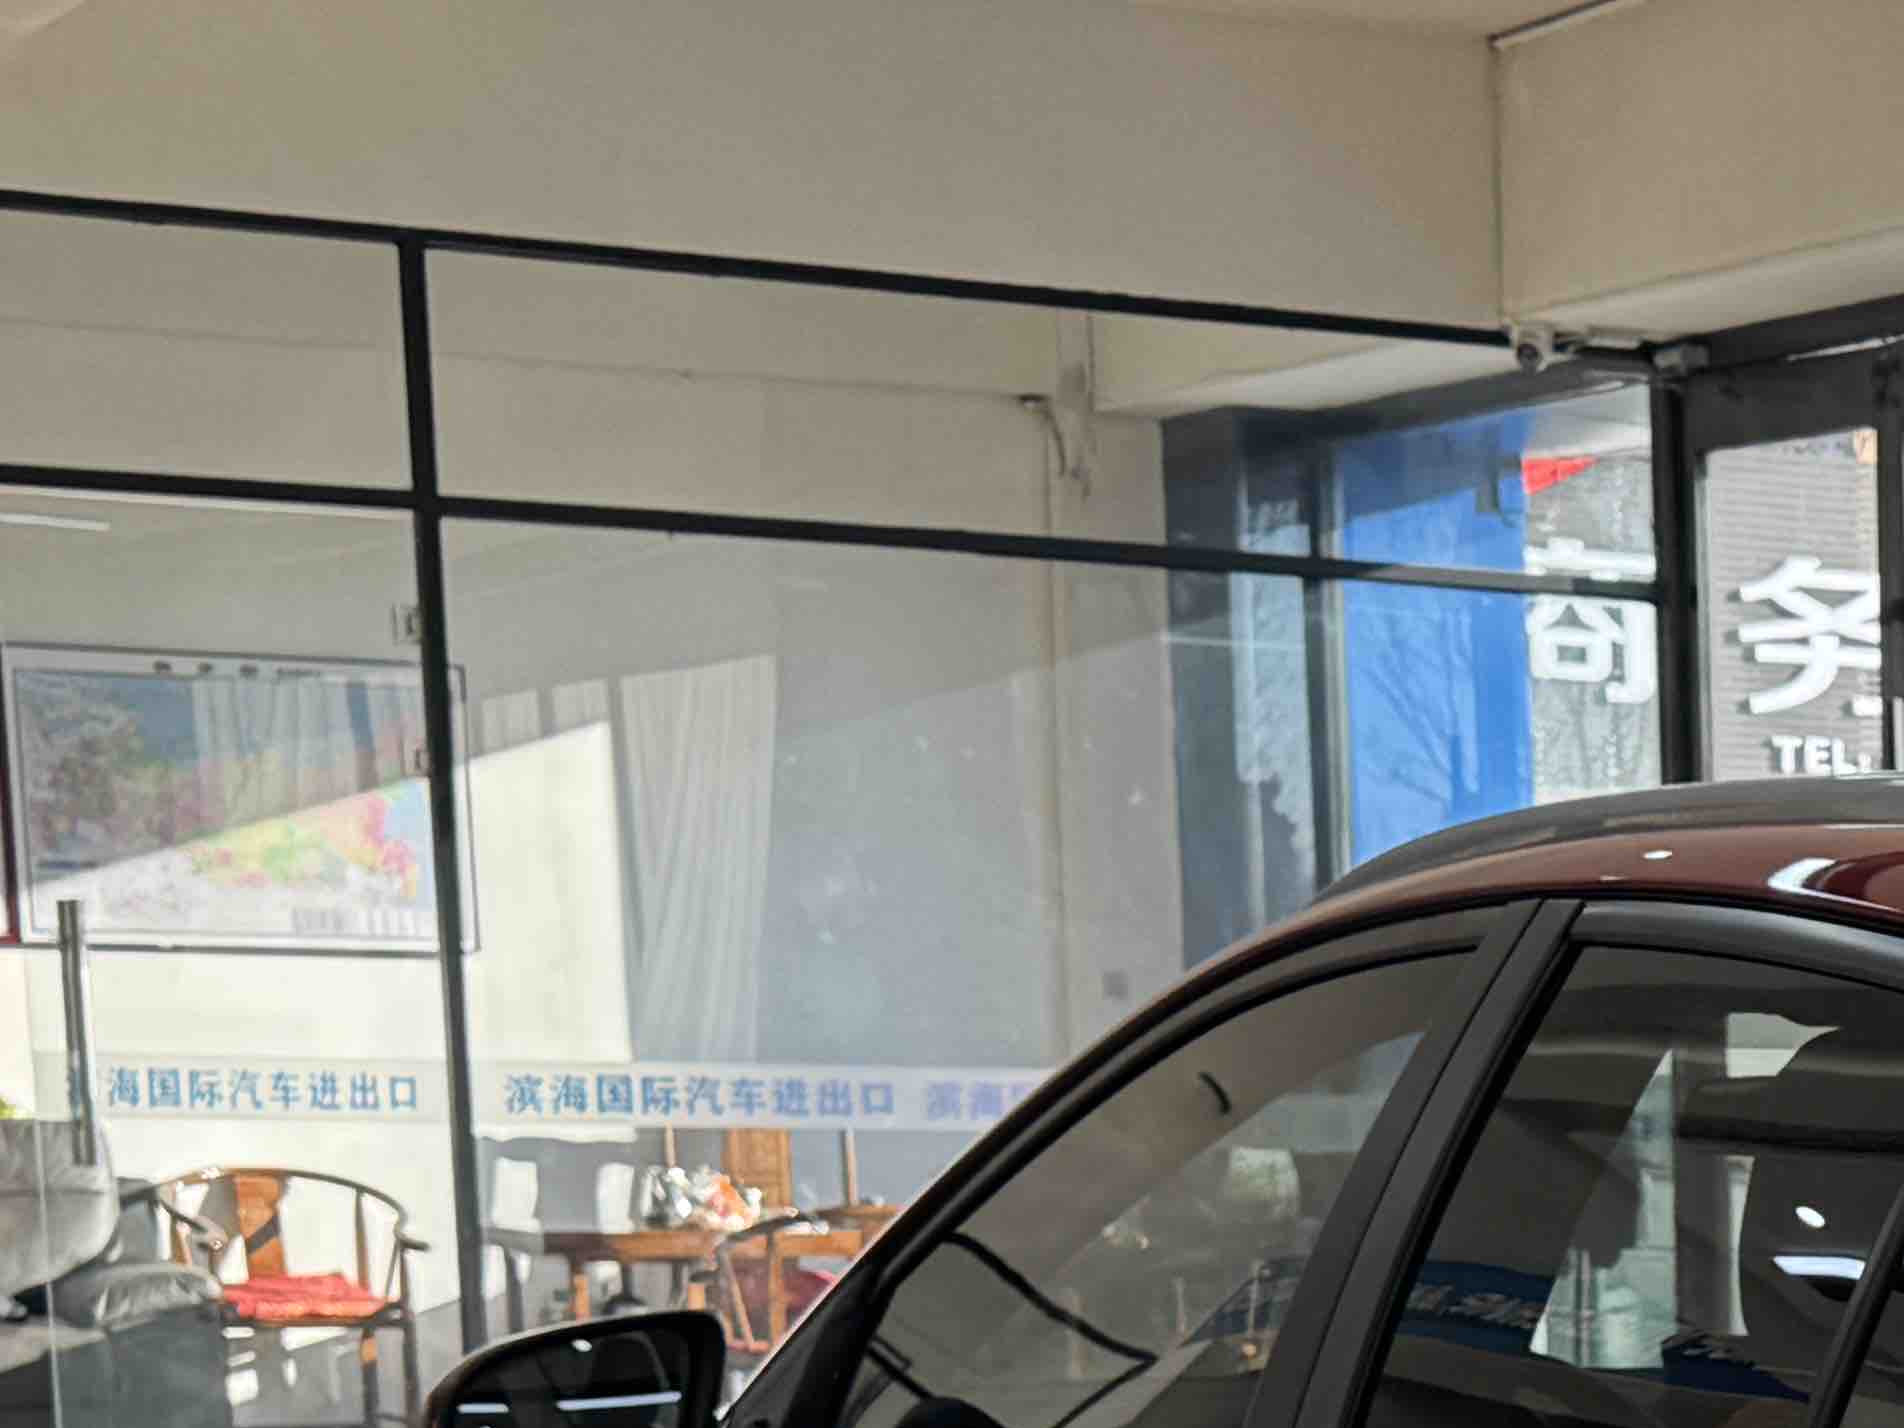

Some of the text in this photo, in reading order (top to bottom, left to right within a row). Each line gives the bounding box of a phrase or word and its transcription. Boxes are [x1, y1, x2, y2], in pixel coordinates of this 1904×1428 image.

[68, 1066, 418, 1112] 海国际汽车进出口
[504, 1072, 895, 1117] 滨海国际汽车进出口
